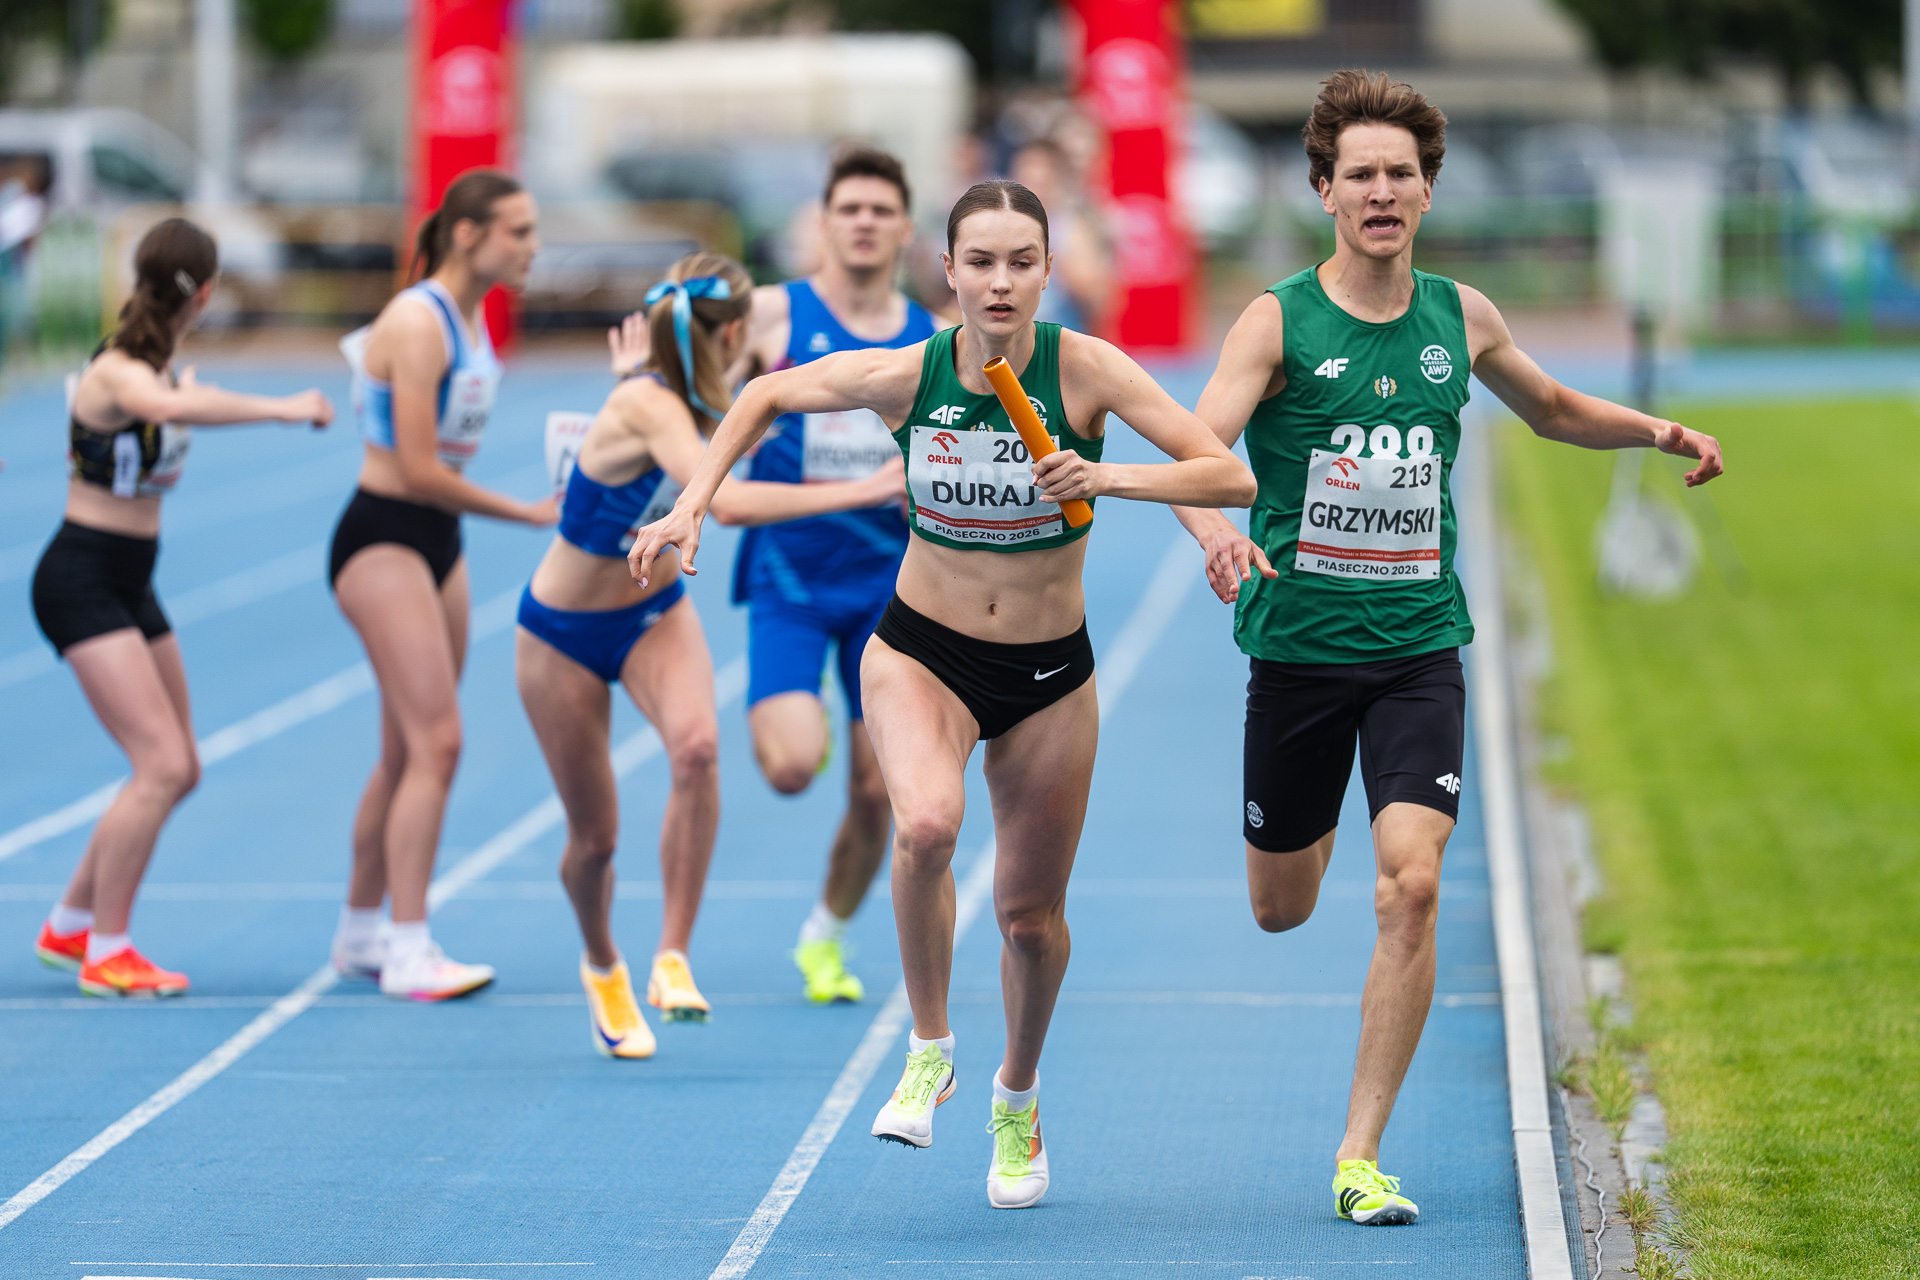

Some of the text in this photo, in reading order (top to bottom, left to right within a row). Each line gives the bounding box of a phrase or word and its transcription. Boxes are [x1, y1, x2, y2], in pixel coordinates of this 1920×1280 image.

[1426, 351, 1445, 360] AZS
[1314, 357, 1350, 379] 4F
[1427, 366, 1448, 376] AWF
[928, 404, 967, 426] 4F
[927, 453, 963, 465] ORLEN
[993, 438, 1037, 464] 20
[1325, 477, 1361, 491] ORLEN
[1390, 462, 1432, 489] 213
[932, 480, 1036, 507] DURAJ
[1308, 501, 1435, 535] GRZYMSKI
[935, 523, 1040, 541] PIASECZNO 2026
[1317, 559, 1419, 575] PIASECZNO 2026
